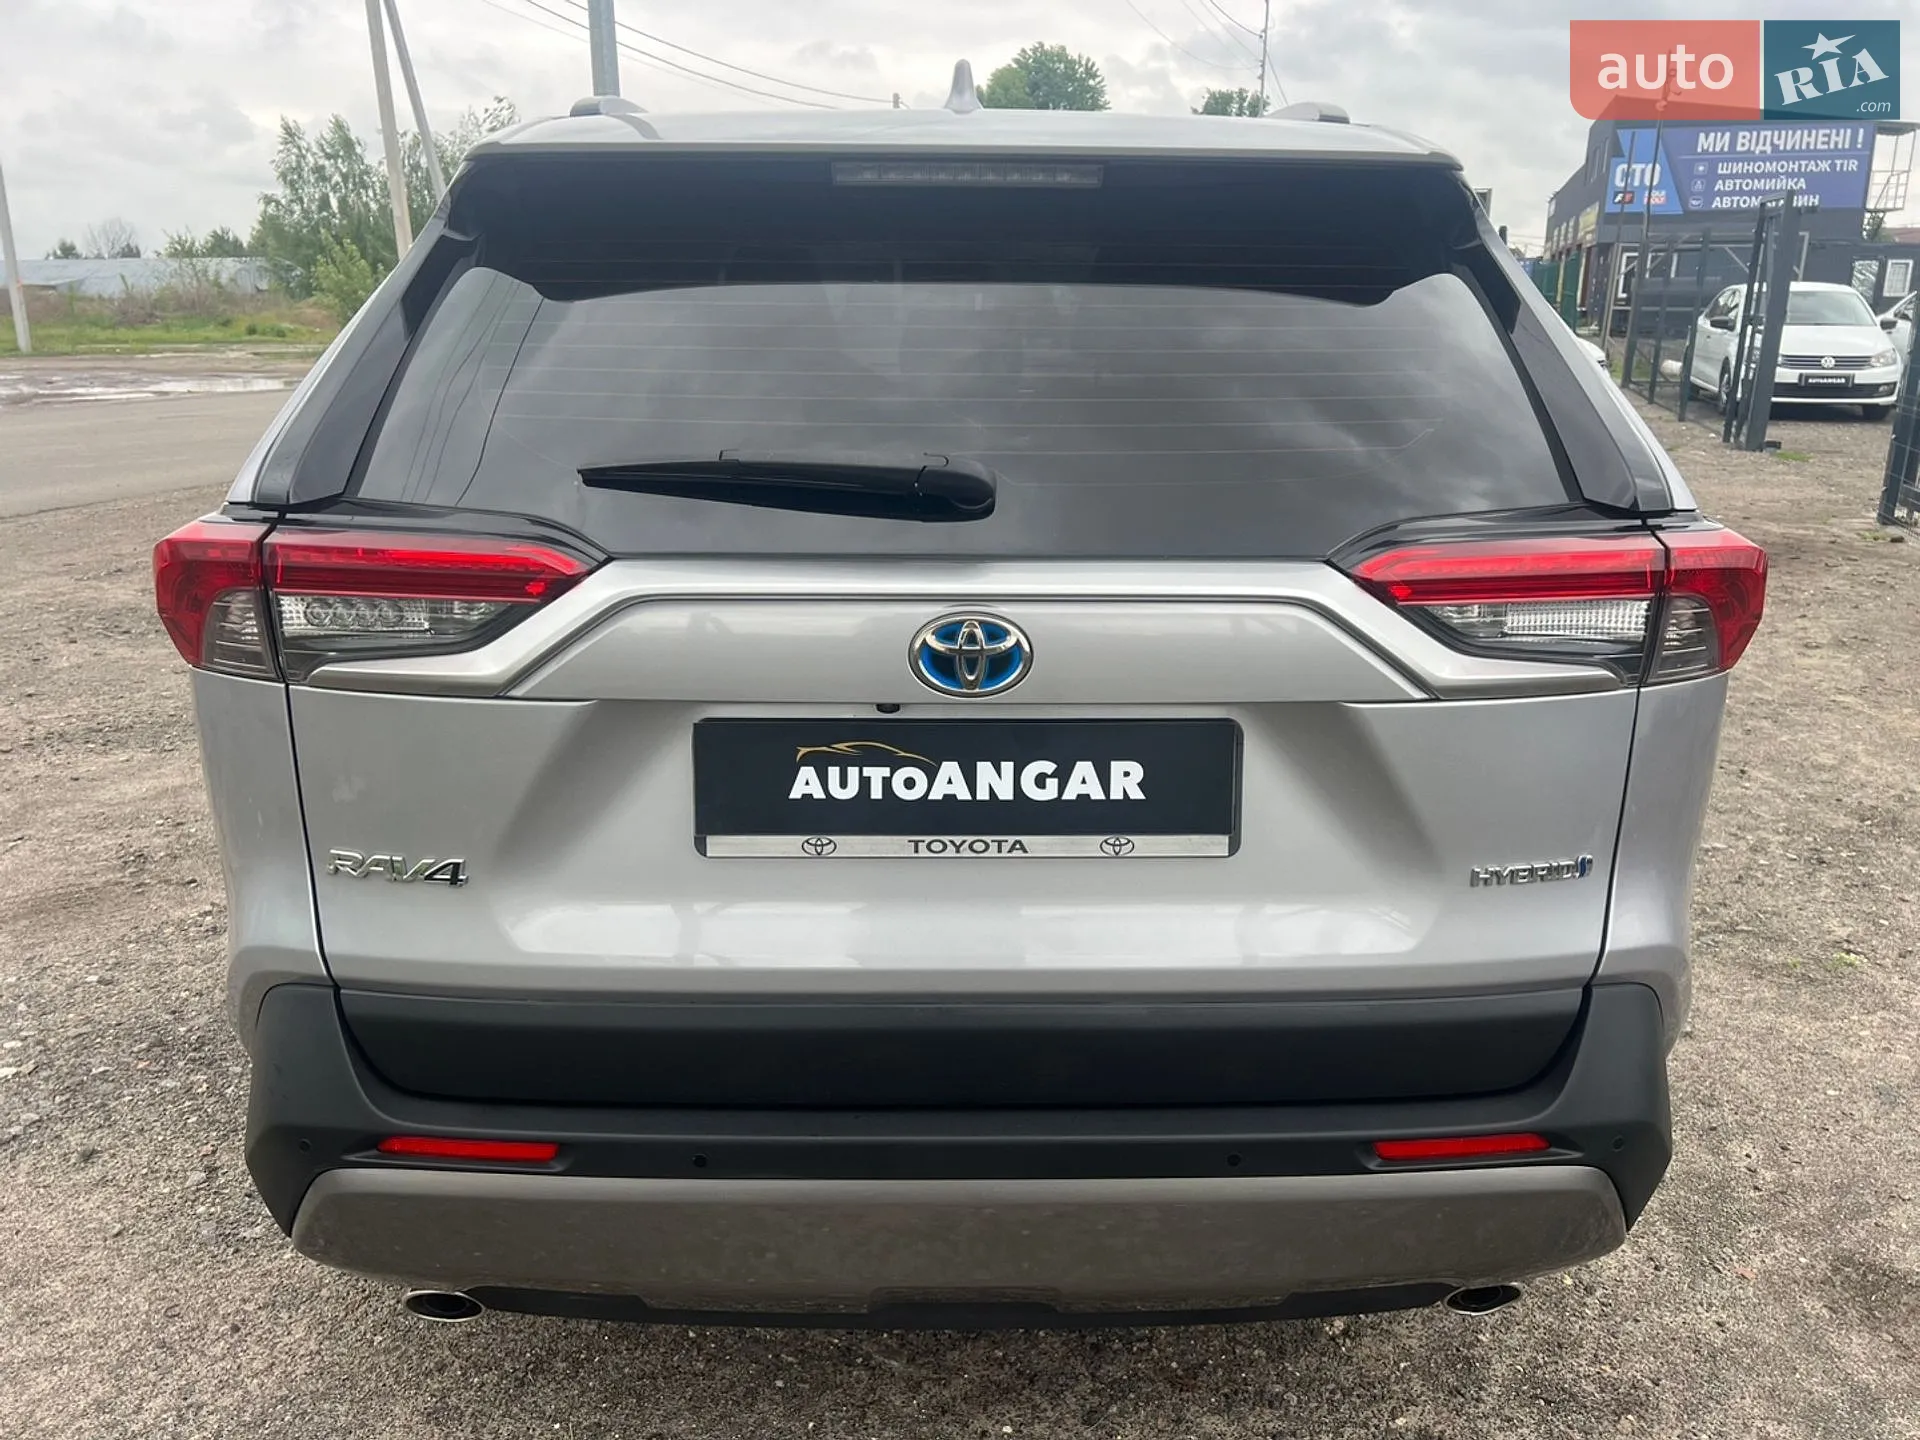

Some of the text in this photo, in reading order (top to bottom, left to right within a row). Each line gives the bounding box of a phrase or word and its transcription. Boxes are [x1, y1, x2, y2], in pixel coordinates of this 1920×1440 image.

[1697, 132, 1730, 152] МИ
[1736, 129, 1852, 154] ВІДЧИНЕНІ
[1615, 163, 1661, 187] СТО
[1717, 159, 1858, 174] ШИНОМОНТАЖ TIR
[1714, 175, 1806, 191] АВТОМИЙКА
[1712, 195, 1820, 208] АВТОМИН
[789, 760, 1146, 800] AUTOANGAR
[908, 839, 1029, 854] TOYOTA
[327, 849, 469, 887] RAV4
[1470, 860, 1577, 887] HYBRID
